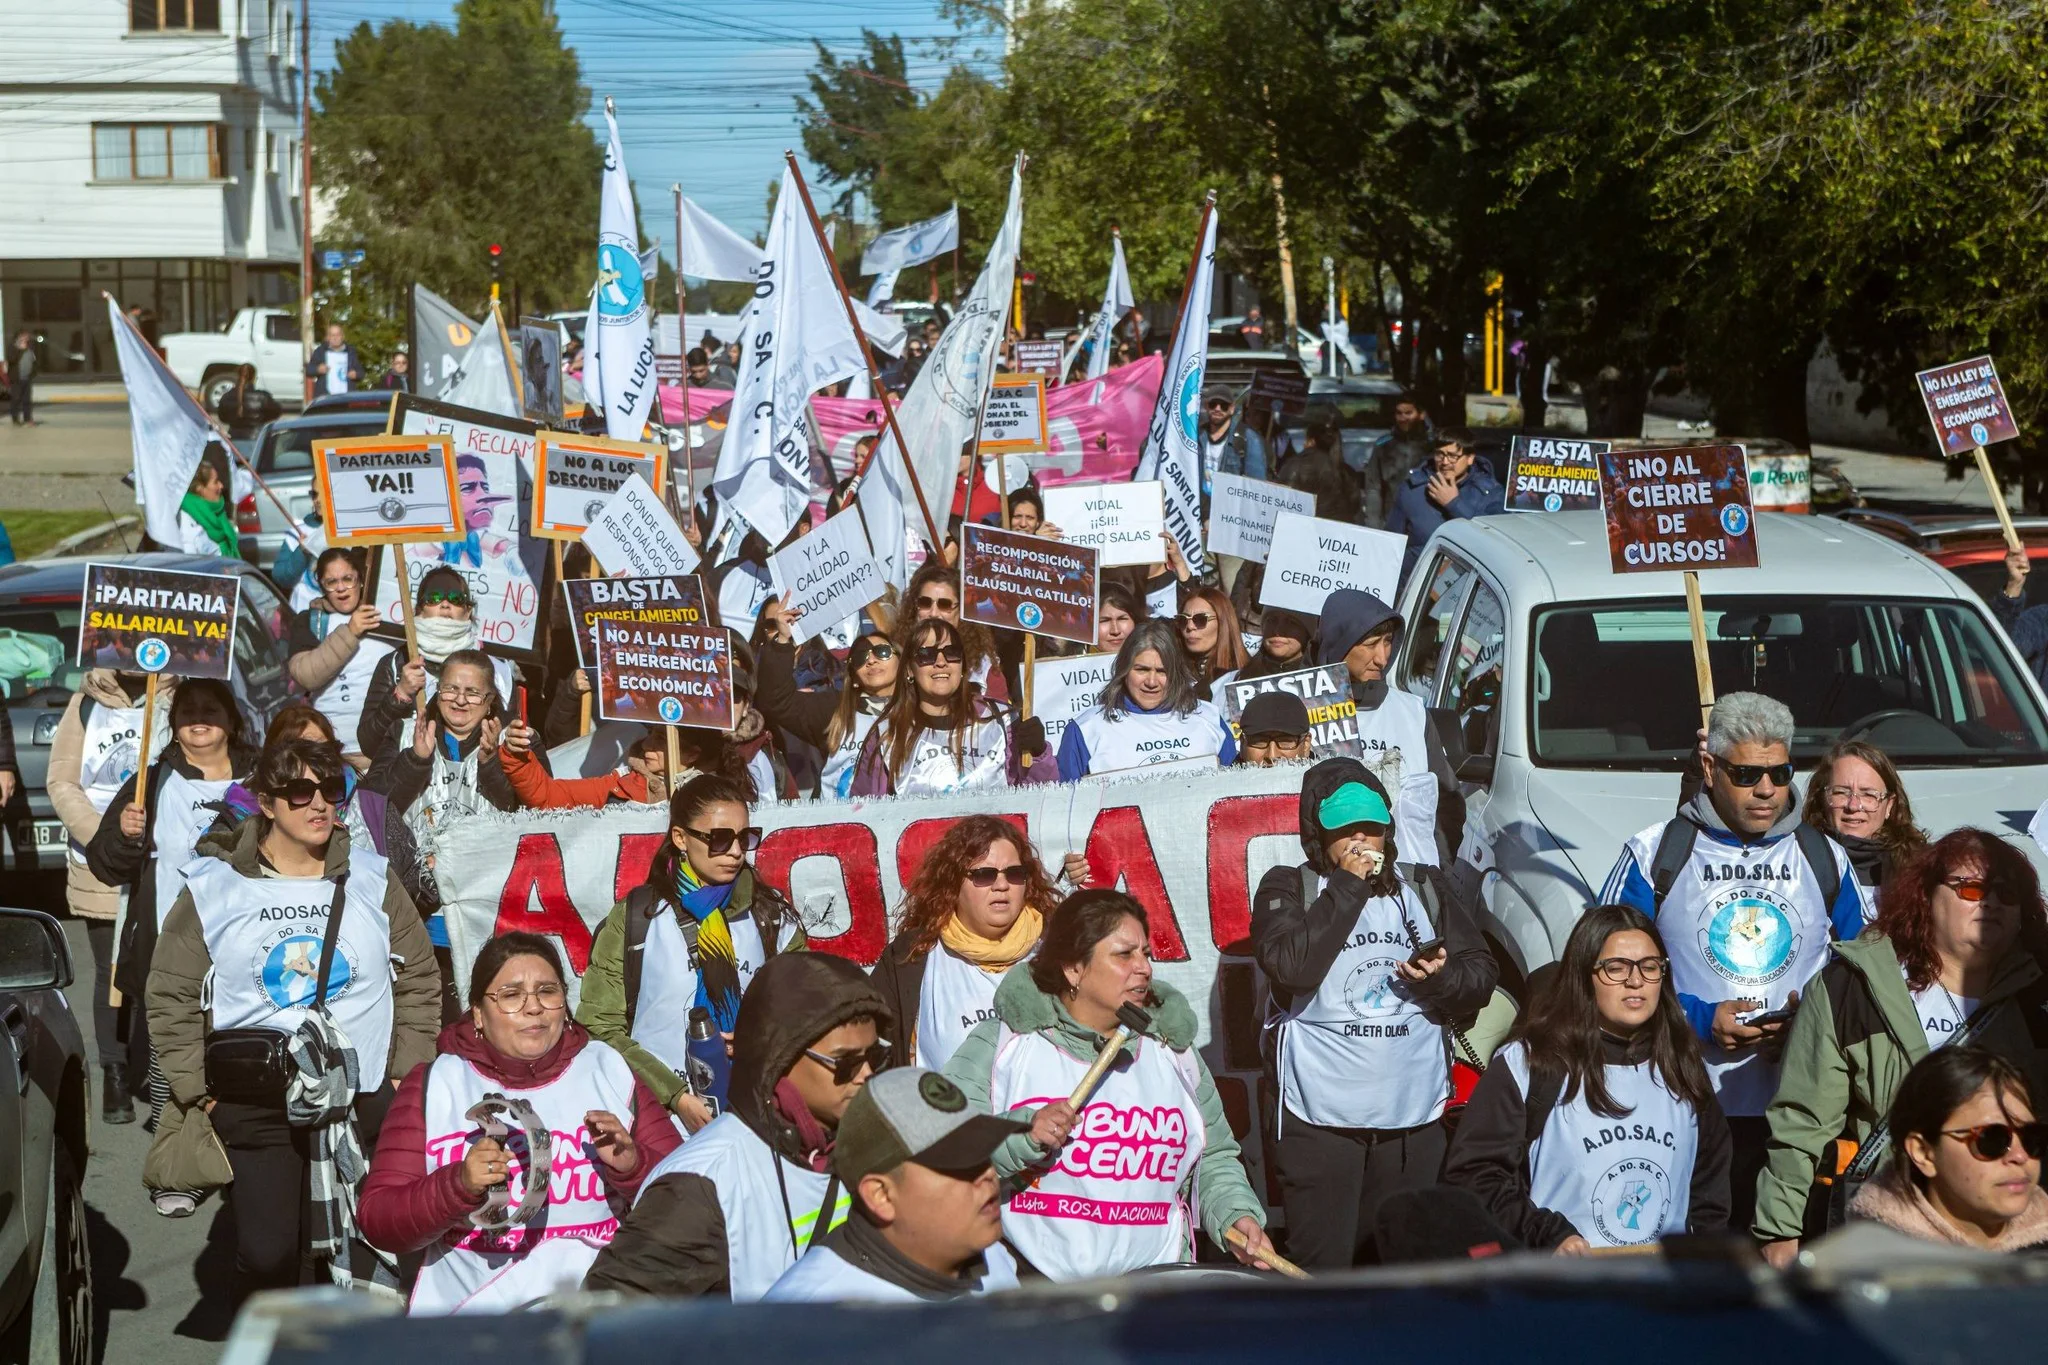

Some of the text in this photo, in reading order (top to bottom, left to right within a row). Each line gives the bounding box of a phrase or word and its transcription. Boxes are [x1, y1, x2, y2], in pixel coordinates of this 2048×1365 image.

[630, 337, 654, 389] LUCH
[1924, 364, 1993, 393] NO A LA LEY DE
[617, 391, 639, 416] LA
[1935, 384, 1996, 410] EMERGENCIA
[1943, 403, 2000, 429] ECONÓMICA
[468, 428, 536, 462] RECLAM
[1528, 439, 1592, 462] BASTA
[339, 453, 432, 468] PARITARIAS
[564, 455, 636, 475] NO A LOS
[1517, 463, 1599, 480] CONGELAMIENTO
[1672, 454, 1700, 476] AL
[365, 472, 414, 494] YA!!
[548, 471, 625, 492] DESCUEN
[1516, 476, 1596, 496] SALARIAL
[1085, 499, 1123, 511] VIDAL
[1227, 486, 1303, 513] CIERRE DE SALAS
[1627, 481, 1713, 508] CIERRE
[626, 490, 686, 571] DÓNDE QUEDÓ
[1657, 513, 1687, 534] DE
[621, 512, 668, 576] EL DIÁLOGO
[1110, 530, 1151, 543] SALAS
[1239, 532, 1271, 546] ALUMN
[1318, 536, 1359, 556] VIDAL
[803, 538, 830, 561] Y LA
[976, 542, 1080, 570] RECOMPOSICIÓN
[1624, 538, 1726, 565] CURSOS!
[796, 550, 850, 592] CALIDAD
[991, 562, 1066, 585] SALARIAL Y
[1280, 570, 1332, 591] CERRO
[95, 584, 227, 614] ¡PARITARIA
[502, 581, 536, 616] NO
[590, 579, 682, 603] BASTA
[966, 575, 1092, 608] CLAUSULA GATILLO!
[89, 612, 227, 639] SALARIAL YA!
[606, 628, 629, 644] NO
[633, 632, 645, 644] A
[647, 632, 668, 647] LA
[671, 633, 700, 651] LEY
[703, 636, 726, 652] DE
[615, 651, 718, 674] EMERGENCIA
[618, 676, 714, 697] ECONÓMICA
[1135, 737, 1191, 753] ADOSAC
[1703, 863, 1791, 882] A.DO.SA.C
[1730, 890, 1752, 899] DO.
[1756, 891, 1775, 904] SA.
[1703, 946, 1715, 965] TODOS
[1713, 960, 1734, 980] JUNTOS
[1733, 973, 1746, 984] POR
[1784, 949, 1796, 971] MEJOR
[255, 974, 268, 1000] TODOS
[1344, 1024, 1383, 1037] CALETA
[1582, 1124, 1676, 1154] A.DO.SA.C.
[1619, 1162, 1636, 1172] DO.
[1639, 1162, 1653, 1174] SA.
[1014, 1192, 1167, 1222] Lista ROSA NACIONAL
